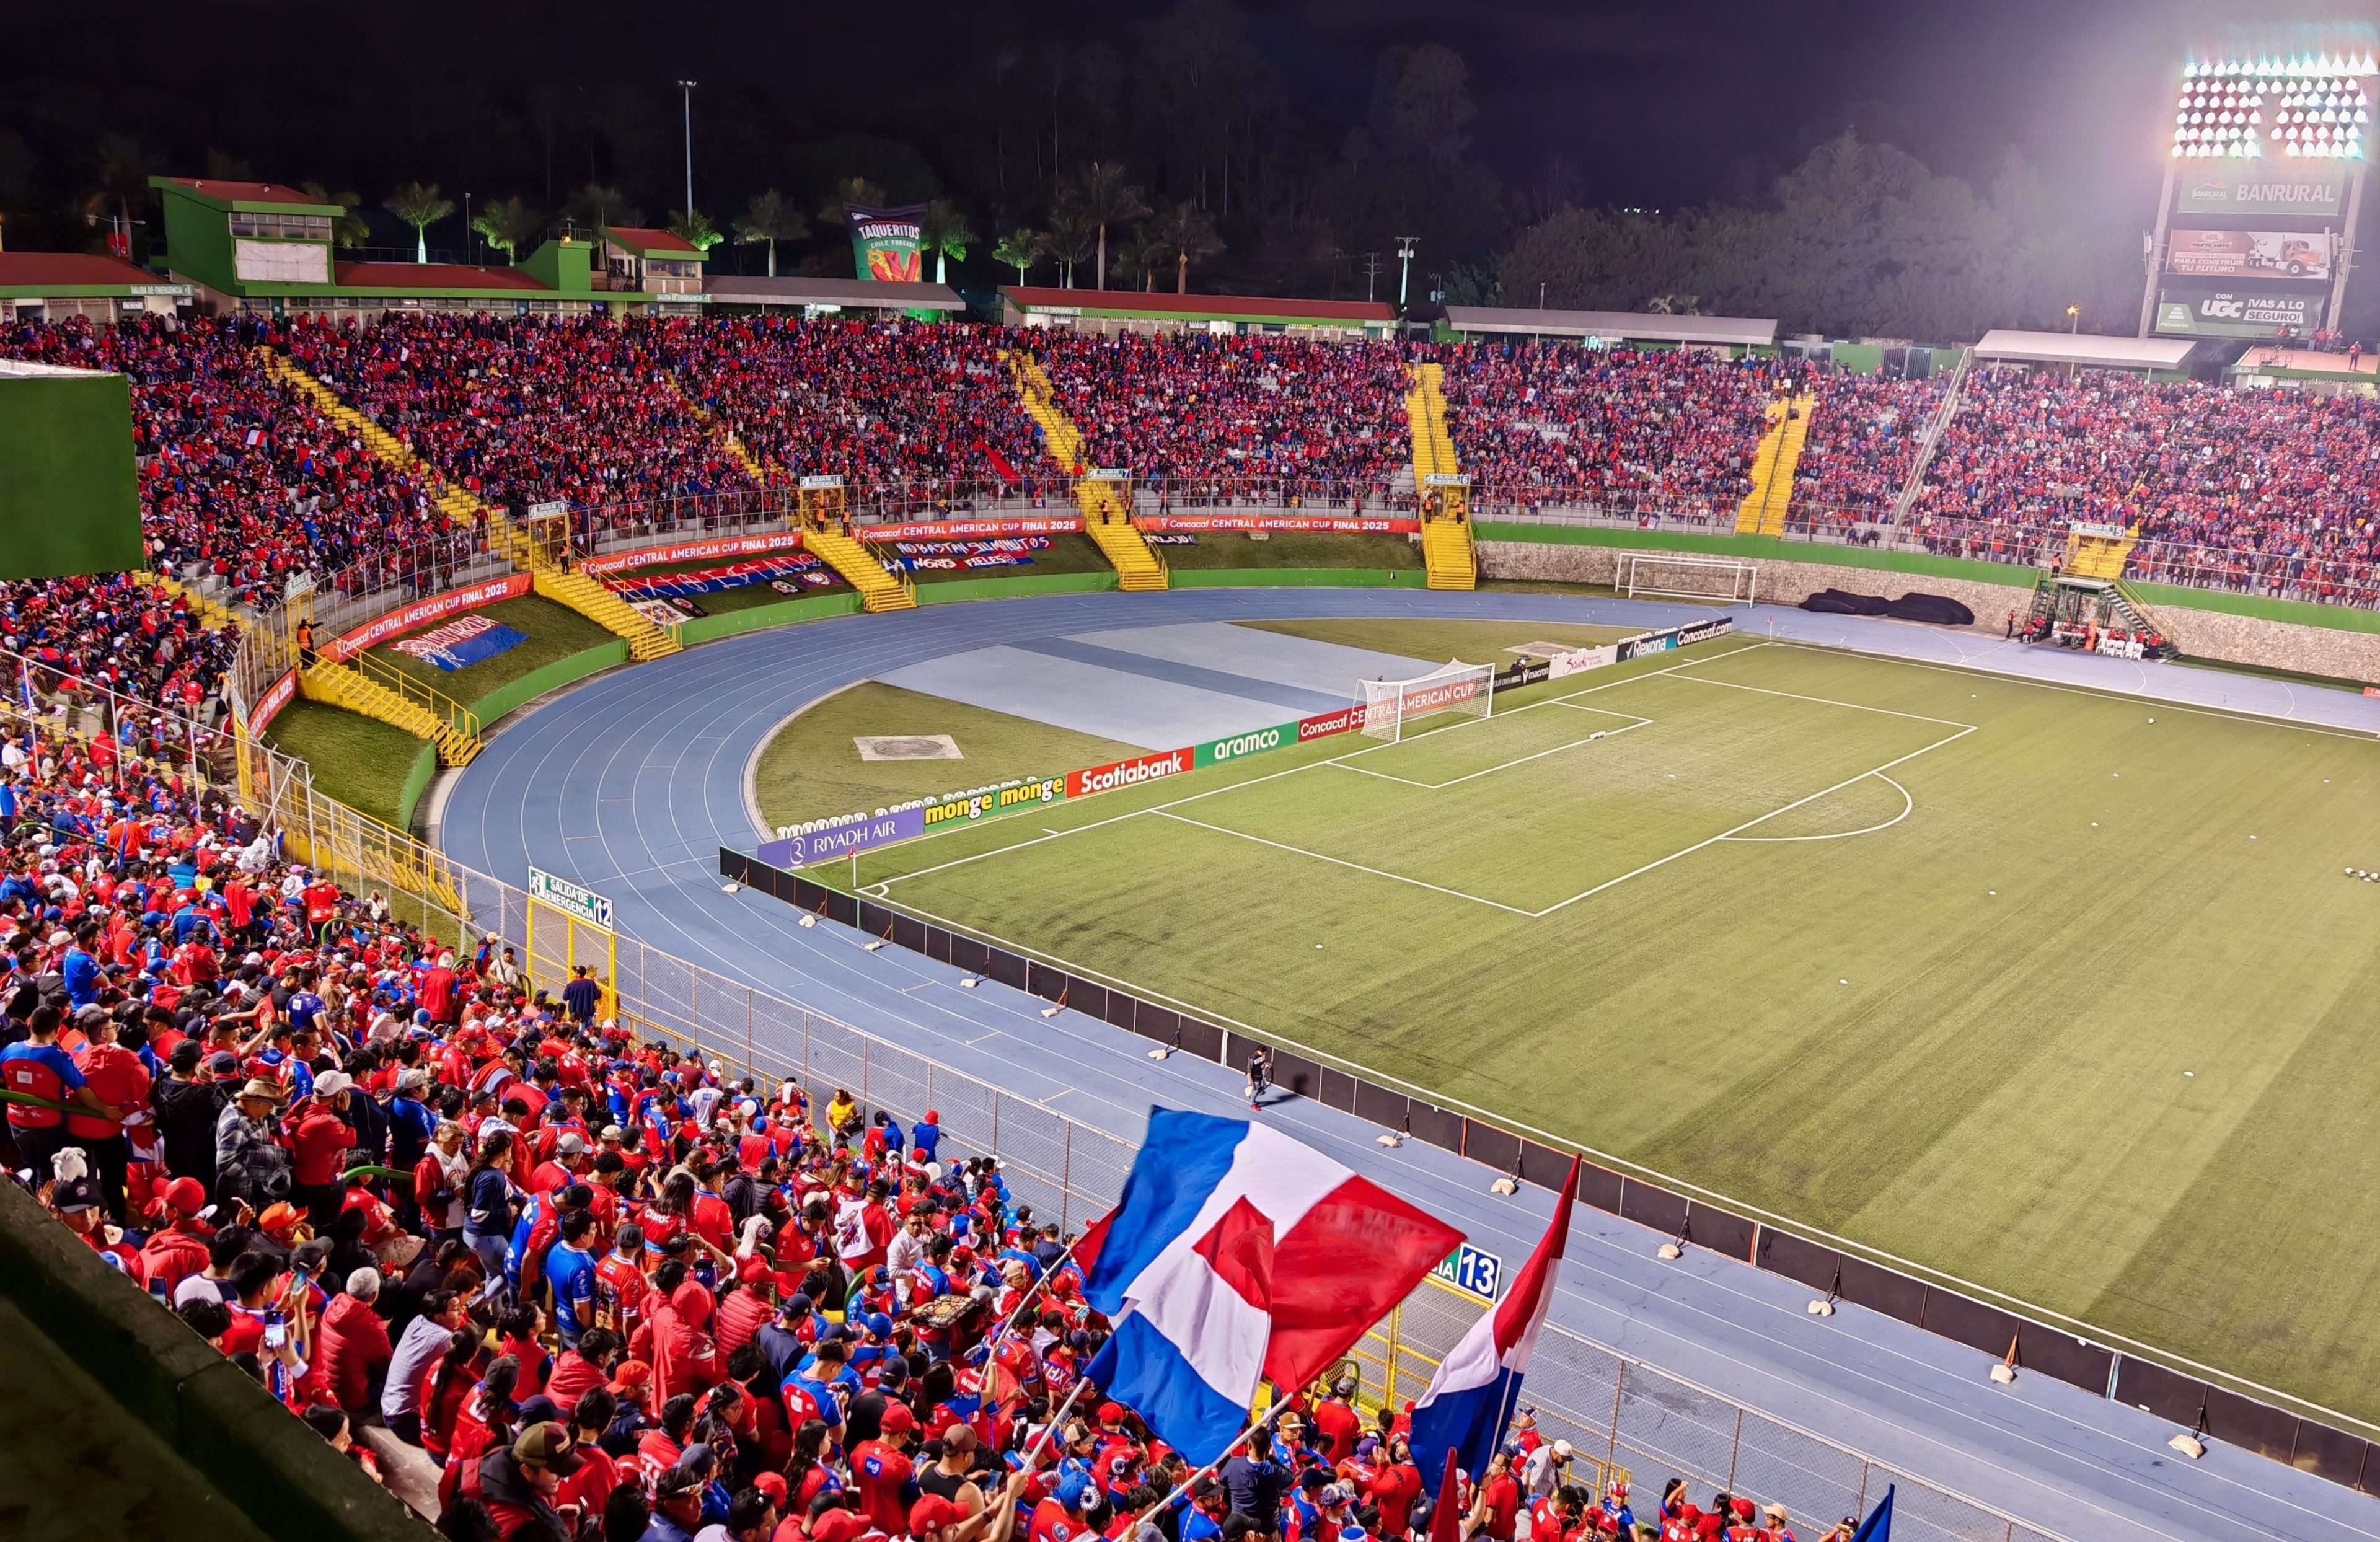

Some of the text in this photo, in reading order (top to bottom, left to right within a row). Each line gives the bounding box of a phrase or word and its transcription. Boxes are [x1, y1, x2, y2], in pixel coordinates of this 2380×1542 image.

[2192, 190, 2228, 199] BANRURAL
[2236, 184, 2335, 203] BANRURAL
[858, 224, 920, 240] TAQUERITOS
[870, 240, 889, 249] CHILE
[2198, 258, 2244, 267] CONSTRUIR
[2201, 300, 2244, 318] UGC
[2273, 300, 2285, 309] A
[2288, 301, 2304, 310] LO
[2247, 311, 2301, 322] SEGURO!
[836, 476, 841, 485] 8
[1124, 469, 1129, 478] 7
[1462, 476, 1468, 484] 6
[560, 501, 565, 512] 9
[863, 521, 1076, 539] Concacaf CENTRAL AMERICAN CUP FINAL 2025
[1170, 519, 1390, 530] Concacaf CENTRAL AMERICAN CUP FINAL 2025
[2115, 528, 2122, 537] 5
[589, 536, 794, 573] Concacaf CENTRAL AMERICAN CUP FINAL 2025
[342, 581, 508, 652] Concacaf CENTRAL AMERICAN CUP FINAL 2025
[1676, 622, 1732, 646] Concacaf.com
[1633, 638, 1666, 658] Rexona
[1528, 667, 1549, 680] macron
[279, 676, 293, 700] 2025
[1300, 716, 1347, 738] Concacaf
[1350, 703, 1398, 725] CENTRAL
[1401, 689, 1451, 711] AMERICAN
[1453, 684, 1474, 699] CUP
[1214, 729, 1279, 760] aramco
[1080, 752, 1182, 794] Scotiabank
[924, 776, 1065, 821] monge monge
[814, 821, 896, 853] RIYADH AIR
[550, 879, 589, 905] SALIDA DE
[546, 889, 594, 921] EMERGENCIA
[596, 899, 611, 927] 12
[645, 1209, 665, 1224] Claro
[1462, 1252, 1496, 1294] 13
[866, 1461, 880, 1474] tigo
